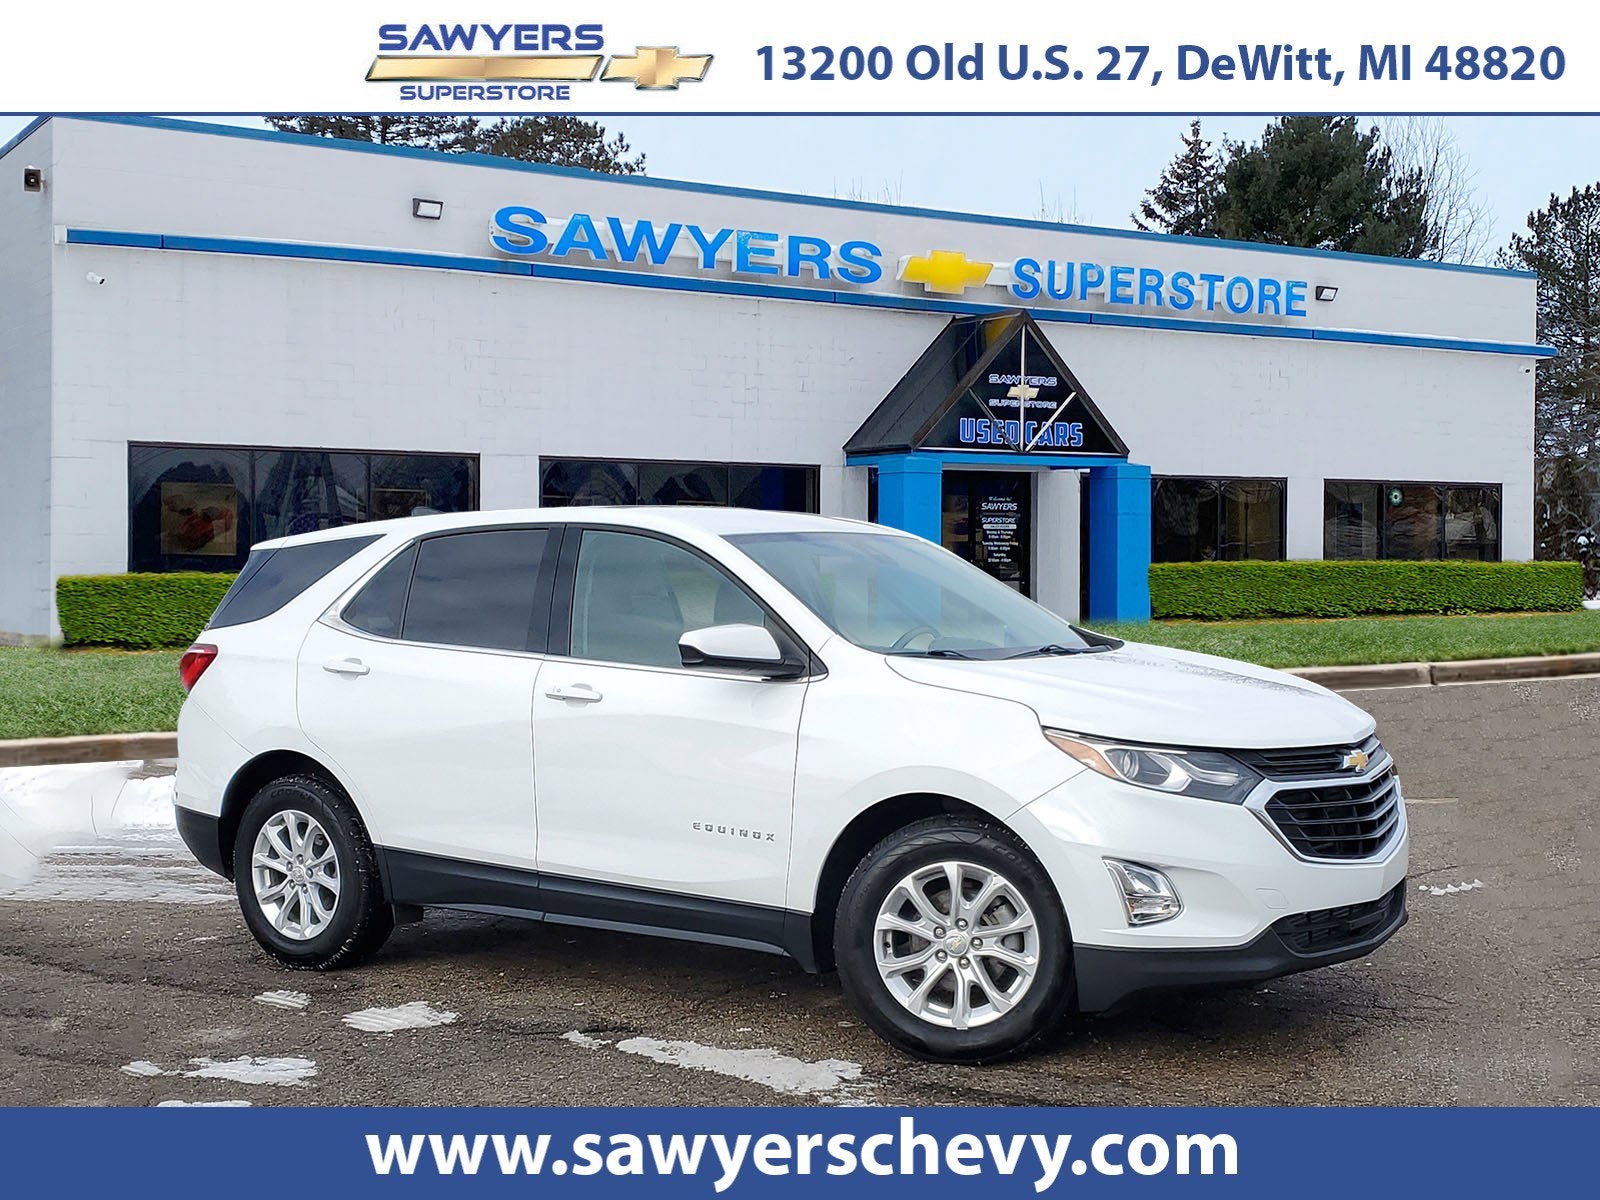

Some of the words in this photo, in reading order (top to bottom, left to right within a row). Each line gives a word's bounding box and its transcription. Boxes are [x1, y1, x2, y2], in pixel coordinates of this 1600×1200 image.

[491, 205, 883, 285] SAWYERS
[1010, 256, 1309, 318] SUPERSTORE
[988, 374, 1058, 387] SAWYERS
[959, 417, 1021, 446] USED
[1024, 420, 1084, 448] CARS
[981, 502, 1018, 511] SAWYERS
[692, 821, 776, 842] EQUINOX
